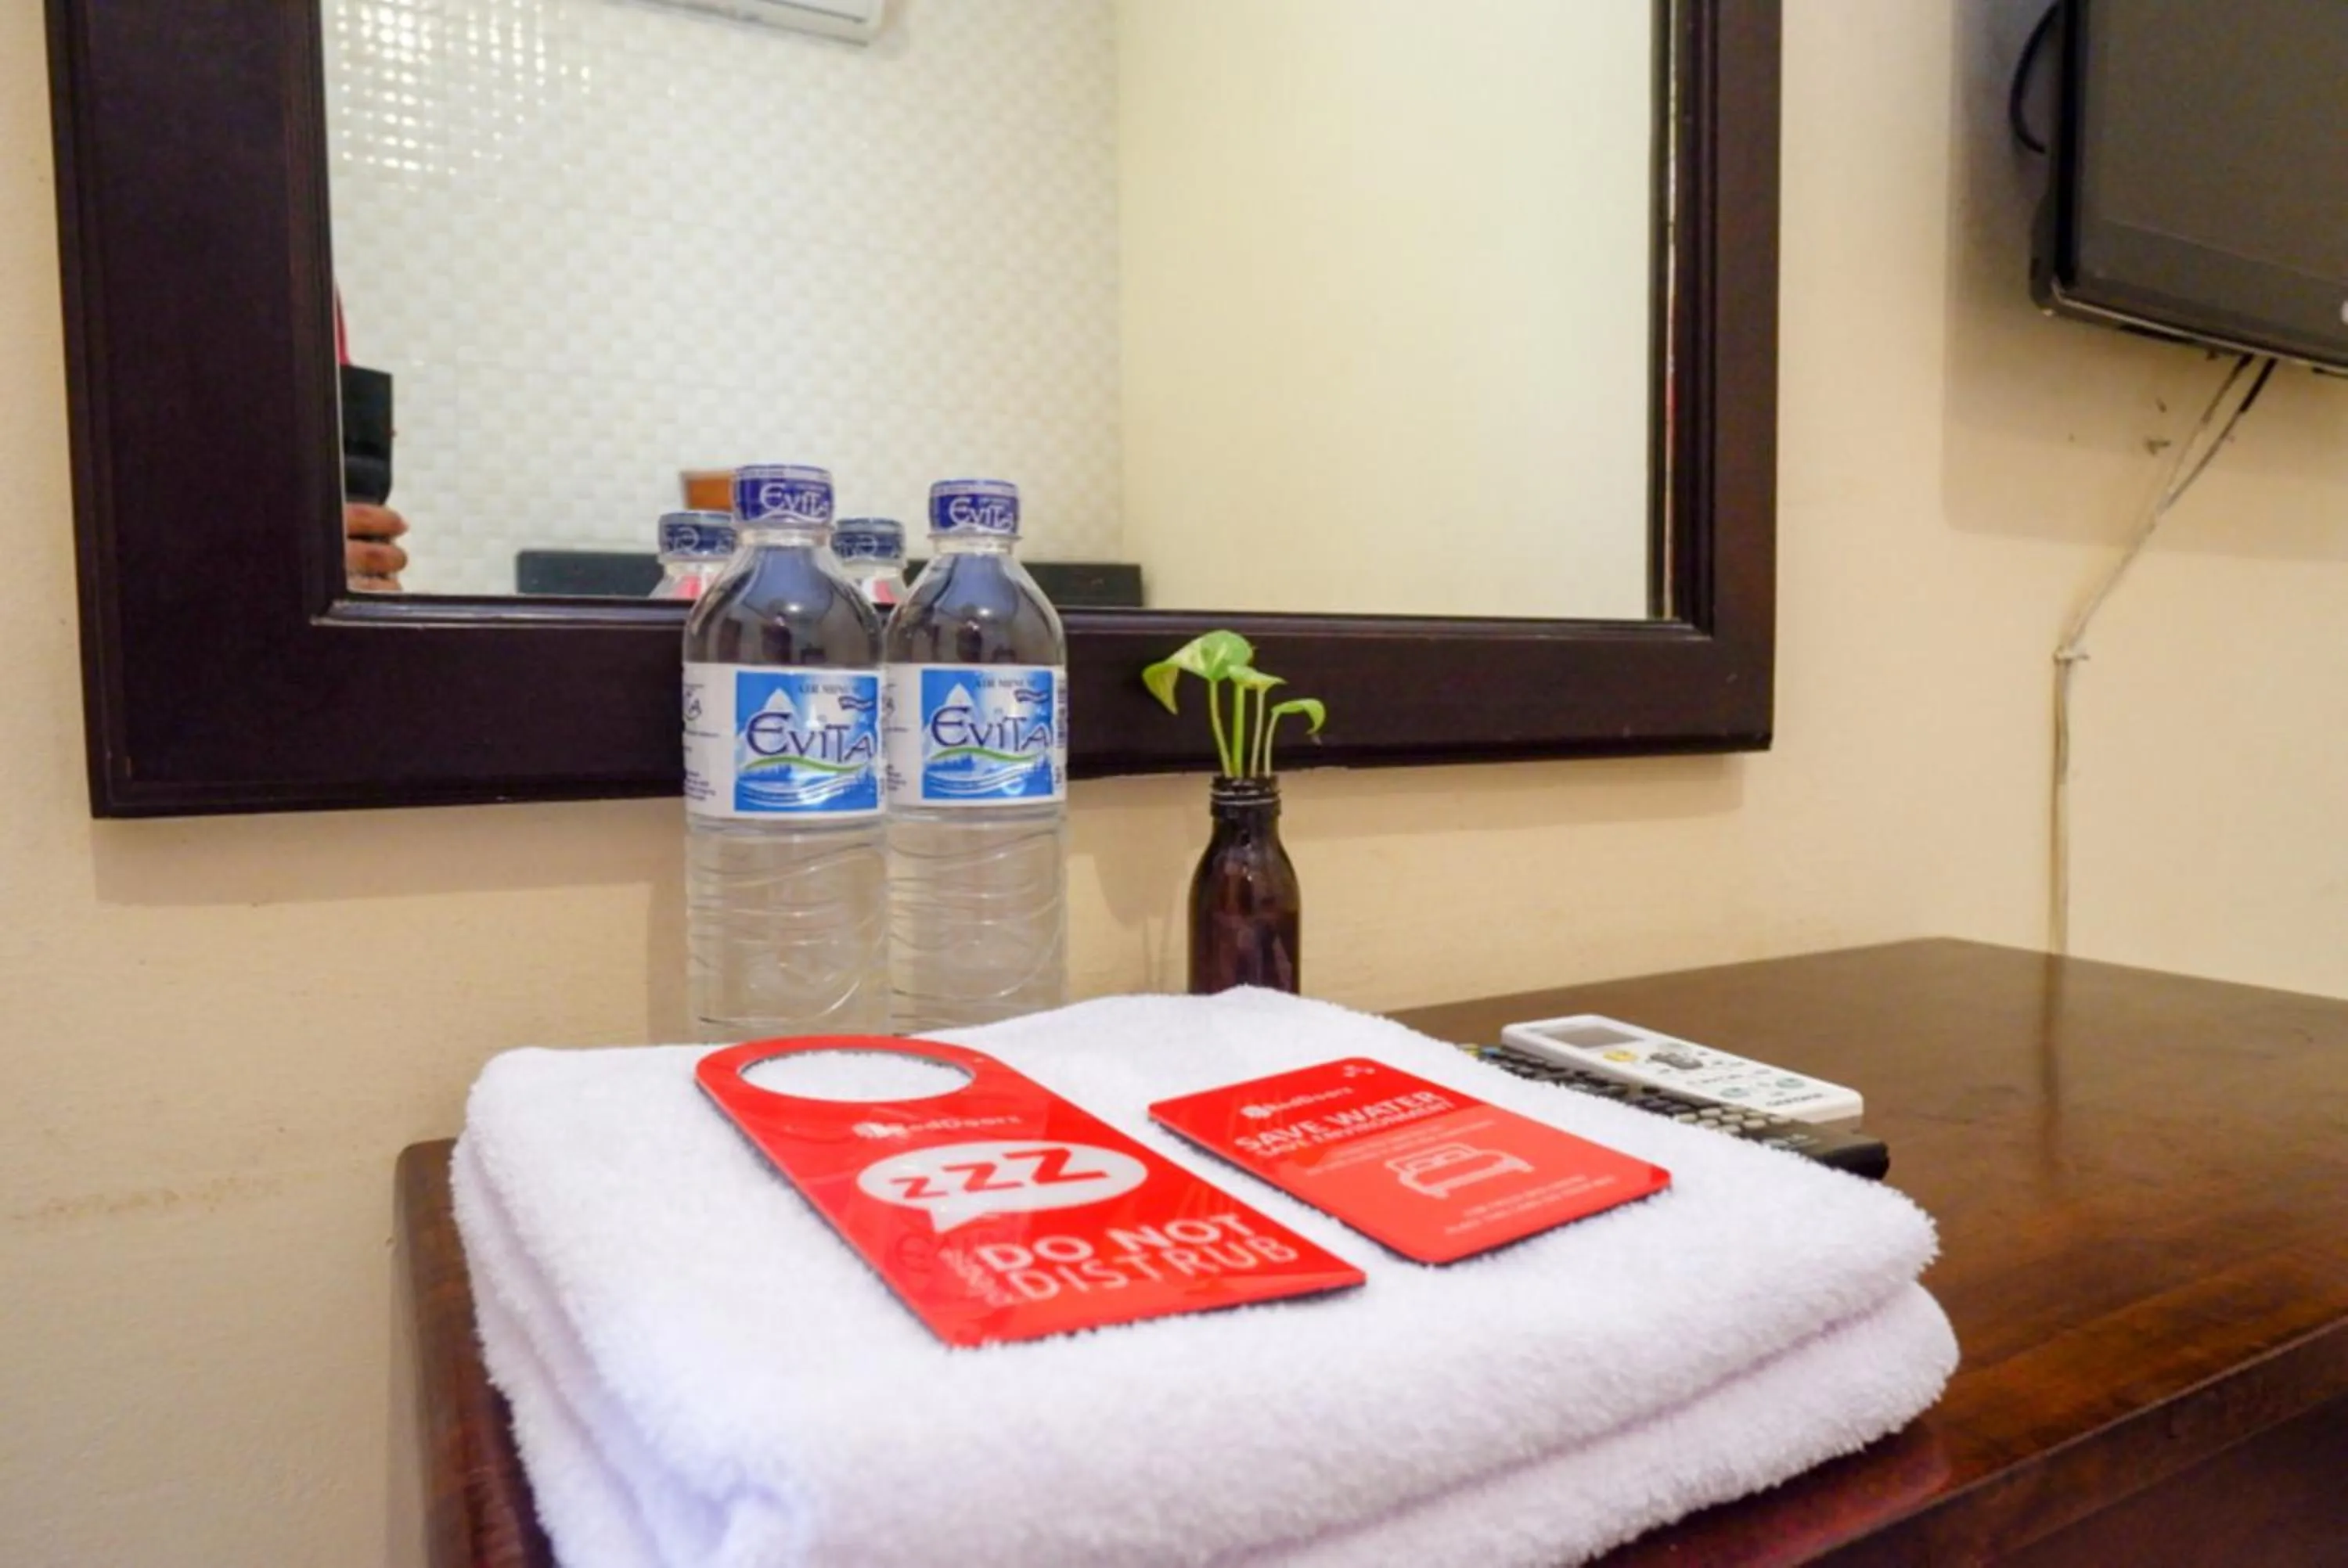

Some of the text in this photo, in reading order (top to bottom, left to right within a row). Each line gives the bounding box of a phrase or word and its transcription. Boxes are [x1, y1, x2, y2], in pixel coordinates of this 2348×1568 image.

[1234, 1120, 1330, 1152] SAVE
[1322, 1090, 1449, 1127] WATER
[976, 1214, 1257, 1271] DO NOT
[1006, 1235, 1299, 1300] DISTRUB
